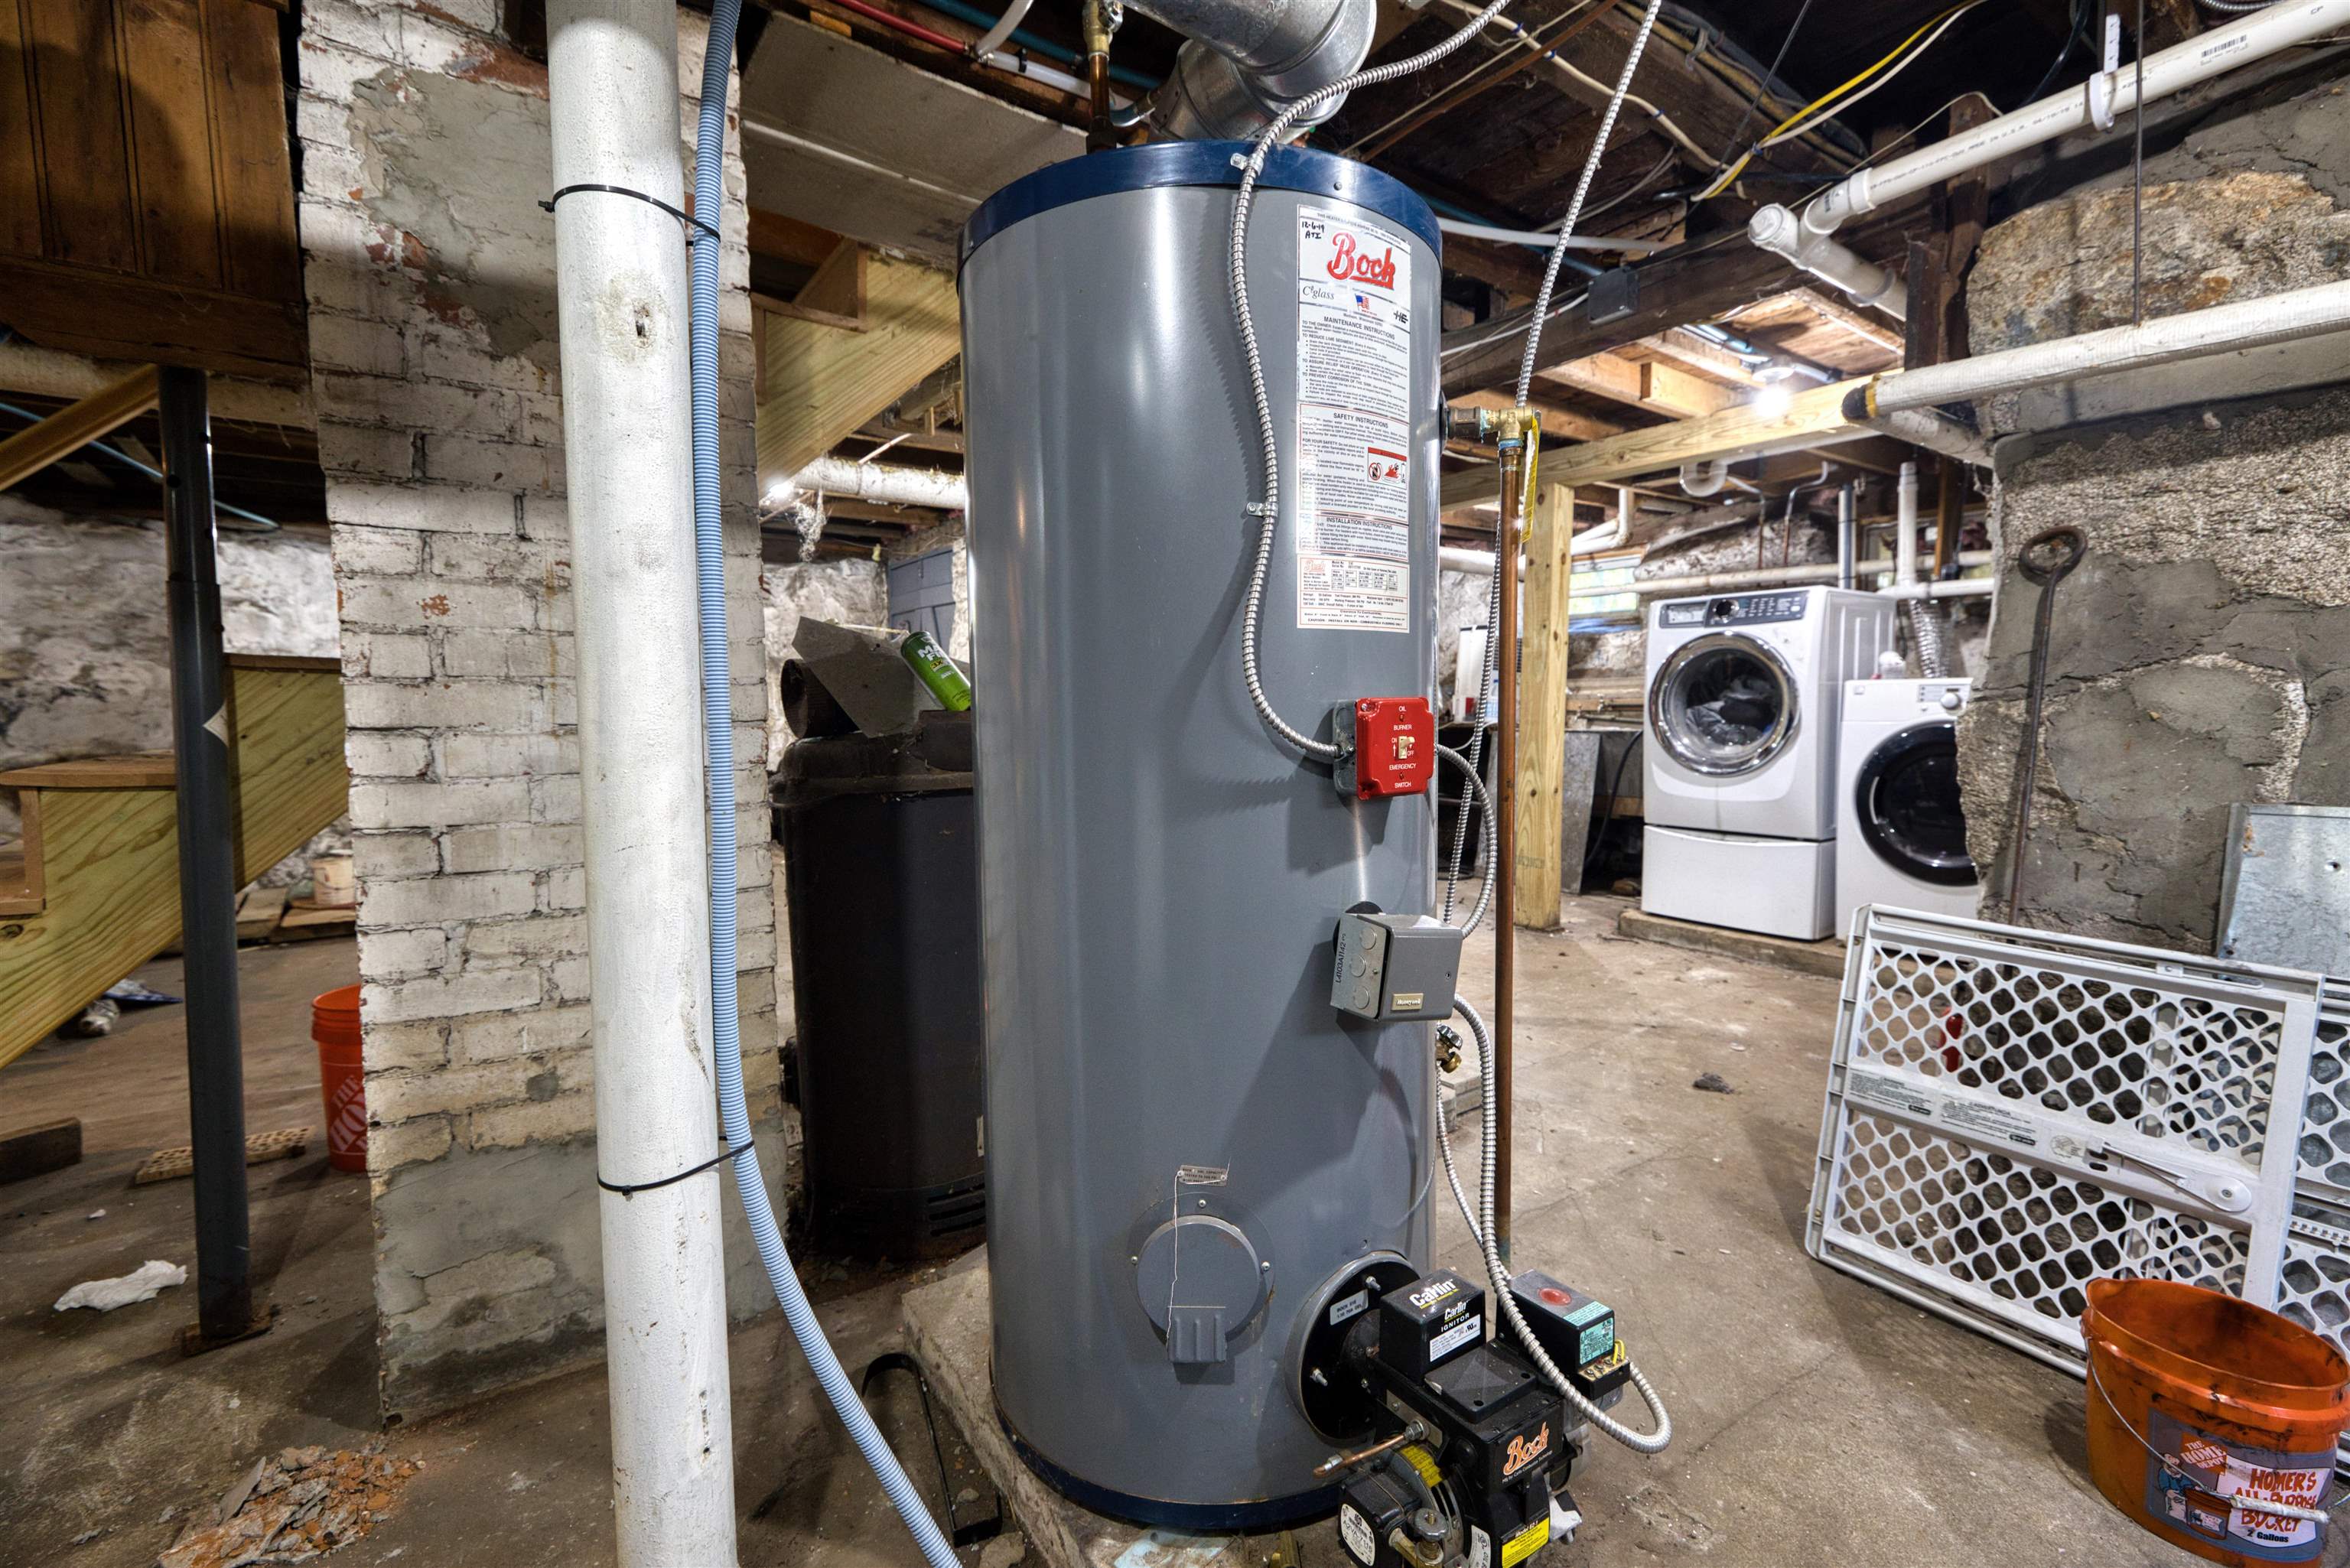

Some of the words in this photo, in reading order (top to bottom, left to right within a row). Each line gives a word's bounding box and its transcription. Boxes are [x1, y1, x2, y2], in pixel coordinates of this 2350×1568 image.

[1327, 232, 1395, 291] Bock
[1324, 316, 1362, 330] MAINTENANCE
[1364, 325, 1395, 340] INSTRUCTIONS
[1334, 412, 1354, 421] SAFETY
[1355, 416, 1388, 429] INSTRUCTIONS
[1326, 517, 1362, 526] INSTALLATION
[1362, 521, 1393, 530] INSTRUCTIONS
[1409, 1279, 1457, 1307] Carlin
[1445, 1301, 1468, 1321] Carlin
[1441, 1313, 1470, 1333] IGNITOR
[1504, 1422, 1549, 1475] Bock
[2185, 1440, 2204, 1450] THE
[2241, 1508, 2302, 1532] BUCKET
[2247, 1529, 2253, 1537] 2
[2257, 1532, 2289, 1543] Gallons
